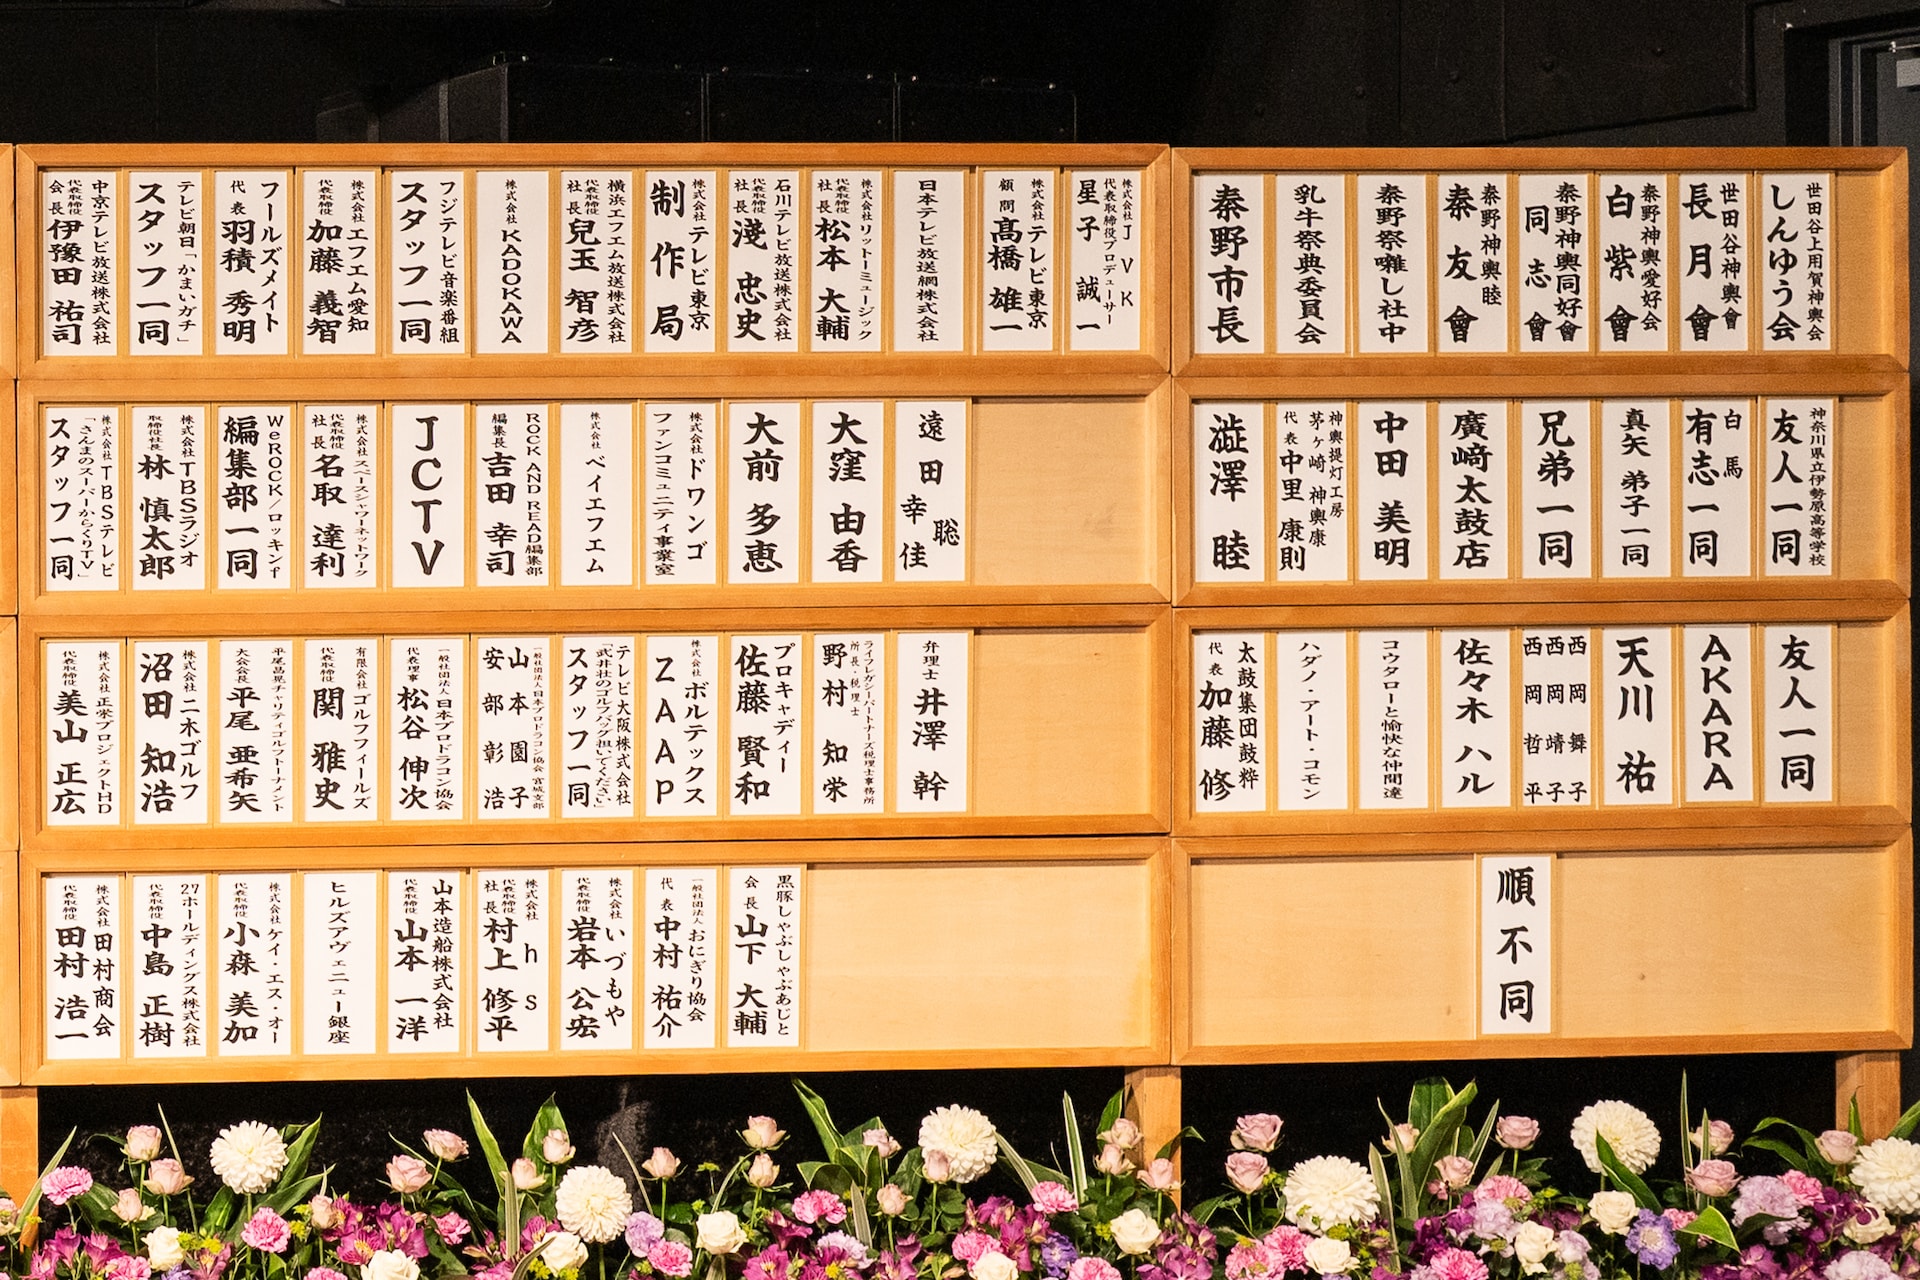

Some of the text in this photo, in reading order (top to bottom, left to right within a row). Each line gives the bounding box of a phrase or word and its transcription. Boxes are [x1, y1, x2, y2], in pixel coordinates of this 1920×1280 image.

[91, 179, 111, 345] 中京テレビ放送株式会社
[135, 183, 171, 346] スタッフ一同
[177, 181, 197, 341] テレビ朝日「かまいガチ」
[220, 180, 258, 344] 代表 羽積秀明
[260, 182, 282, 332] フールズメイト
[346, 180, 369, 333] 株式会社エフエム愛知
[397, 182, 433, 344] スタッフ一同
[439, 182, 459, 344] フジテレビ音楽番組
[607, 179, 626, 343] 横浜エフエム放送株式会社
[650, 179, 685, 341] 制作局
[688, 179, 710, 331] 株式会社テレビ東京
[774, 179, 792, 341] 石川テレビ放送株式会社
[859, 179, 874, 340] 株式会社リットーミュージック
[916, 180, 939, 342] 日本テレビ放送網株式会社
[999, 178, 1015, 213] 顧問
[1026, 178, 1048, 329] 株式会社テレビ東京
[1076, 179, 1101, 330] 星子誠一
[1103, 178, 1117, 324] 代表取締役プロデューサー
[1208, 184, 1249, 344] 秦野市長
[1293, 184, 1327, 344] 乳牛祭典委員会
[1374, 183, 1408, 343] 秦野祭囃し社中
[1443, 183, 1479, 343] 秦友會
[1480, 183, 1502, 305] 秦野神輿睦
[1524, 205, 1552, 342] 同志會
[1553, 181, 1583, 342] 秦野神輿同好會
[1604, 184, 1639, 342] 白紫會
[1638, 183, 1662, 331] 秦野神輿愛好会
[1682, 183, 1719, 341] 長月會
[1720, 182, 1742, 330] 世田谷神輿會
[1766, 184, 1801, 341] しんゆう会
[1806, 182, 1824, 341] 世田谷上用賀神輿会
[306, 219, 344, 344] 加藤義智
[814, 217, 851, 341] 松本大輔
[49, 418, 74, 581] スタッフ一同
[100, 415, 114, 577] 株式会社TBSテレビ
[179, 415, 199, 567] 株式会社TBSラジオ
[222, 415, 259, 579] 編集部一同
[411, 416, 444, 575] JCTV
[482, 413, 517, 576] 編集長 吉田幸司
[526, 413, 541, 456] ROCK
[527, 462, 541, 494] AND
[585, 412, 606, 573] 株式会社ベイエフエム
[652, 413, 675, 576] ファンコミュニティ事業室
[687, 412, 707, 560] 株式会社ドワンゴ
[743, 412, 784, 572] 大前多恵
[827, 411, 868, 573] 大窪由香
[918, 410, 946, 485] 遠田
[1278, 411, 1306, 571] 代表 中里康則
[1329, 410, 1344, 518] 神輿提灯工房
[1373, 411, 1411, 568] 中田美明
[1536, 410, 1575, 568] 兄弟一同
[1620, 408, 1651, 567] 真矢弟子一同
[1686, 408, 1720, 567] 有志一同
[1723, 409, 1743, 479] 白馬
[1771, 408, 1803, 566] 友人一同
[1809, 407, 1826, 566] 神奈川県立伊勢原高等学校
[137, 454, 175, 580] 林慎太郎
[310, 454, 347, 577] 名取達利
[51, 689, 88, 814] 美山正広
[140, 653, 176, 813] 沼田知浩
[180, 650, 201, 799] 株式会社二木ゴルフ
[224, 687, 262, 812] 平尾亜希矢
[311, 687, 346, 810] 関雅史
[354, 647, 371, 808] 有限会社ゴルフフィールズ
[397, 647, 430, 809] 代表理事 松谷伸次
[434, 649, 454, 810] 一般社団法人日本プロドラコン協会
[482, 647, 505, 810] 安部彰浩
[508, 647, 529, 809] 山本園子
[567, 648, 591, 807] スタッフ一同
[616, 646, 631, 805] テレビ大阪株式会社
[655, 657, 675, 805] ZAAP
[684, 640, 709, 804] 株式会社ボルテックス
[734, 644, 771, 805] 佐藤賢和
[773, 643, 795, 773] プロキャディー
[822, 643, 848, 803] 野村知栄
[912, 640, 949, 801] 弁理士 井澤幹
[1197, 642, 1236, 801] 代表 加藤修
[1237, 641, 1259, 790] 太鼓集団鼓粋
[1299, 642, 1322, 799] ハダノ・アート・コモン
[1381, 641, 1403, 799] コウタローと愉快な仲間達
[1453, 638, 1494, 794] 佐々木ハル
[1523, 636, 1543, 804] 西岡哲平
[1545, 636, 1565, 803] 西岡靖子
[1568, 635, 1587, 802] 西岡舞子
[1616, 636, 1656, 794] 天川祐
[1701, 634, 1733, 791] AKARA
[1779, 634, 1816, 791] 友人一同
[54, 926, 89, 1039] 田村浩一
[93, 885, 115, 1037] 株式会社田村商会
[139, 923, 175, 1047] 中島正樹
[181, 884, 200, 1047] 27ホールディングス株式会社
[222, 922, 260, 1044] 小森美加
[328, 882, 351, 1044] ヒルズアヴェニュー銀座
[394, 918, 429, 1041] 山本一洋
[432, 879, 454, 1029] 山本造船株式会社
[481, 917, 518, 1042] 村上修平
[566, 916, 601, 1038] 岩本公宏
[651, 878, 683, 1038] 代表 中村祐介
[687, 880, 706, 1021] 一般社団法人おにぎり協会
[733, 875, 768, 1036] 会長 山下大輔
[775, 875, 794, 1035] 黒豚しゃぶしゃぶあじと
[1496, 866, 1536, 1023] 順不同
